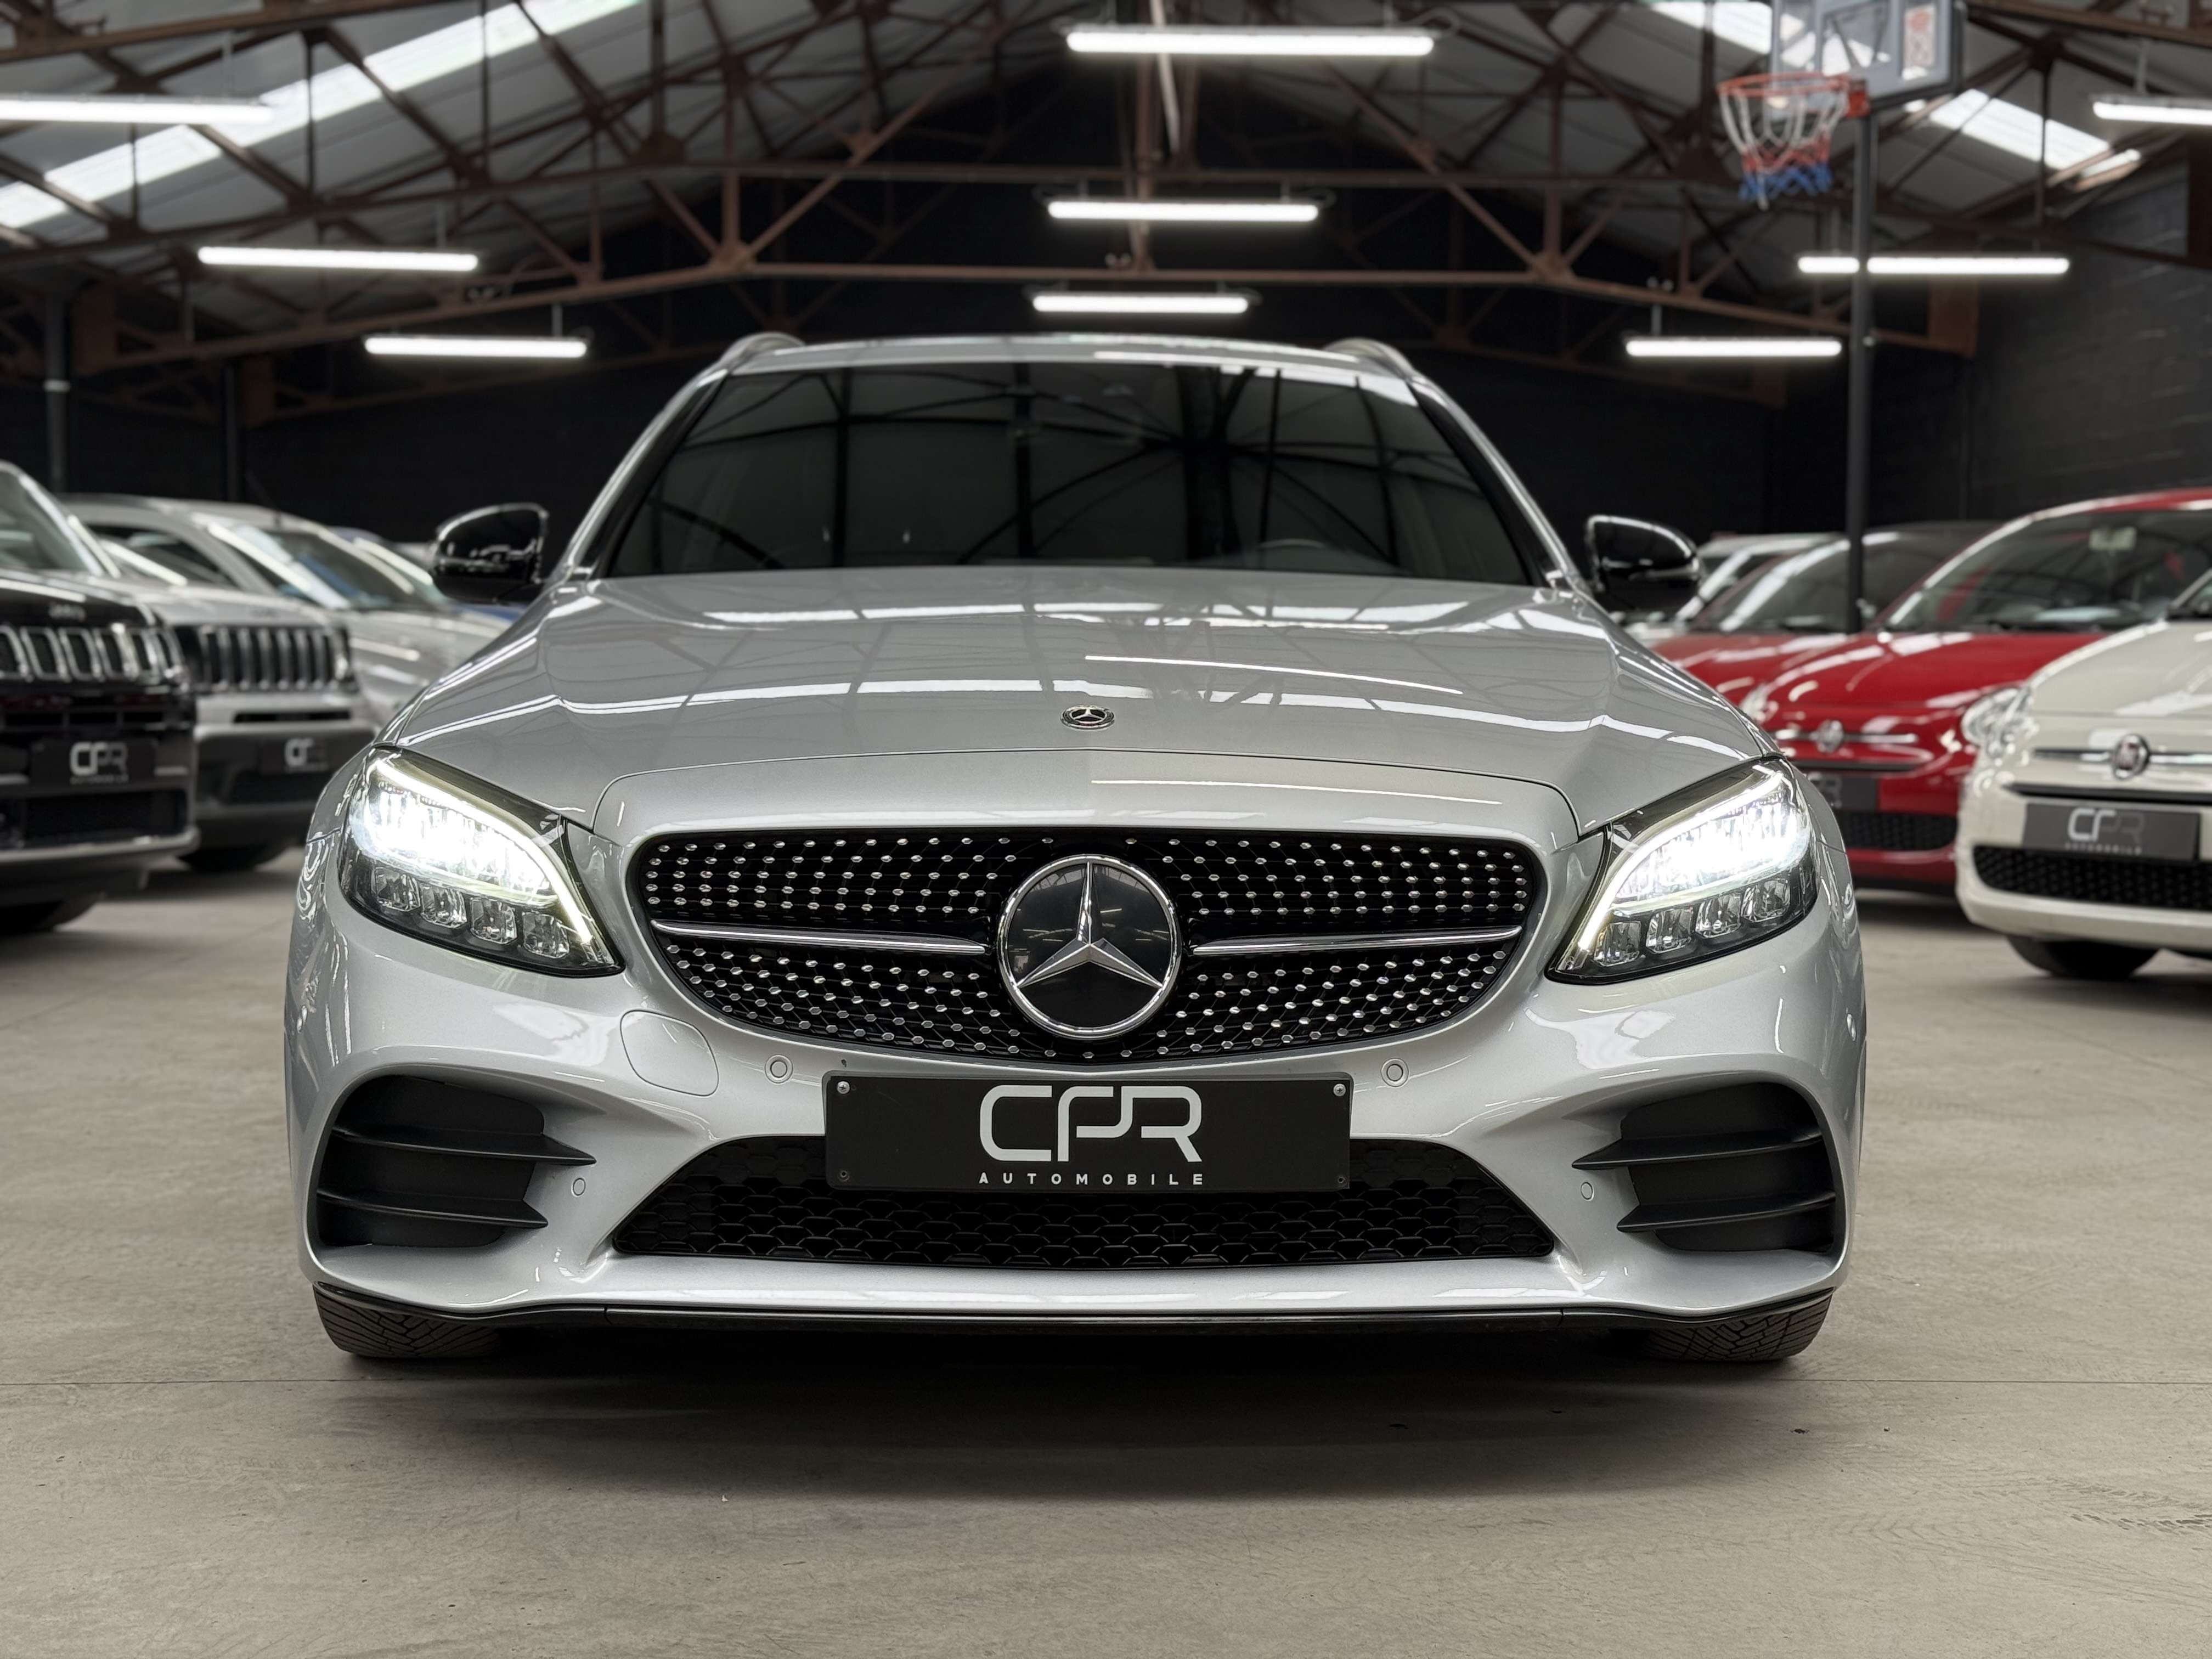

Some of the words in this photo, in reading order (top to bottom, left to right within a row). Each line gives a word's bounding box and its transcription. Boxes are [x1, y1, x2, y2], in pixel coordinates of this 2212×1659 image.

[70, 742, 127, 776] CPR
[2068, 808, 2145, 843] CPR
[980, 1085, 1202, 1162] CPR
[979, 1172, 1202, 1186] AUTOMOBILE
